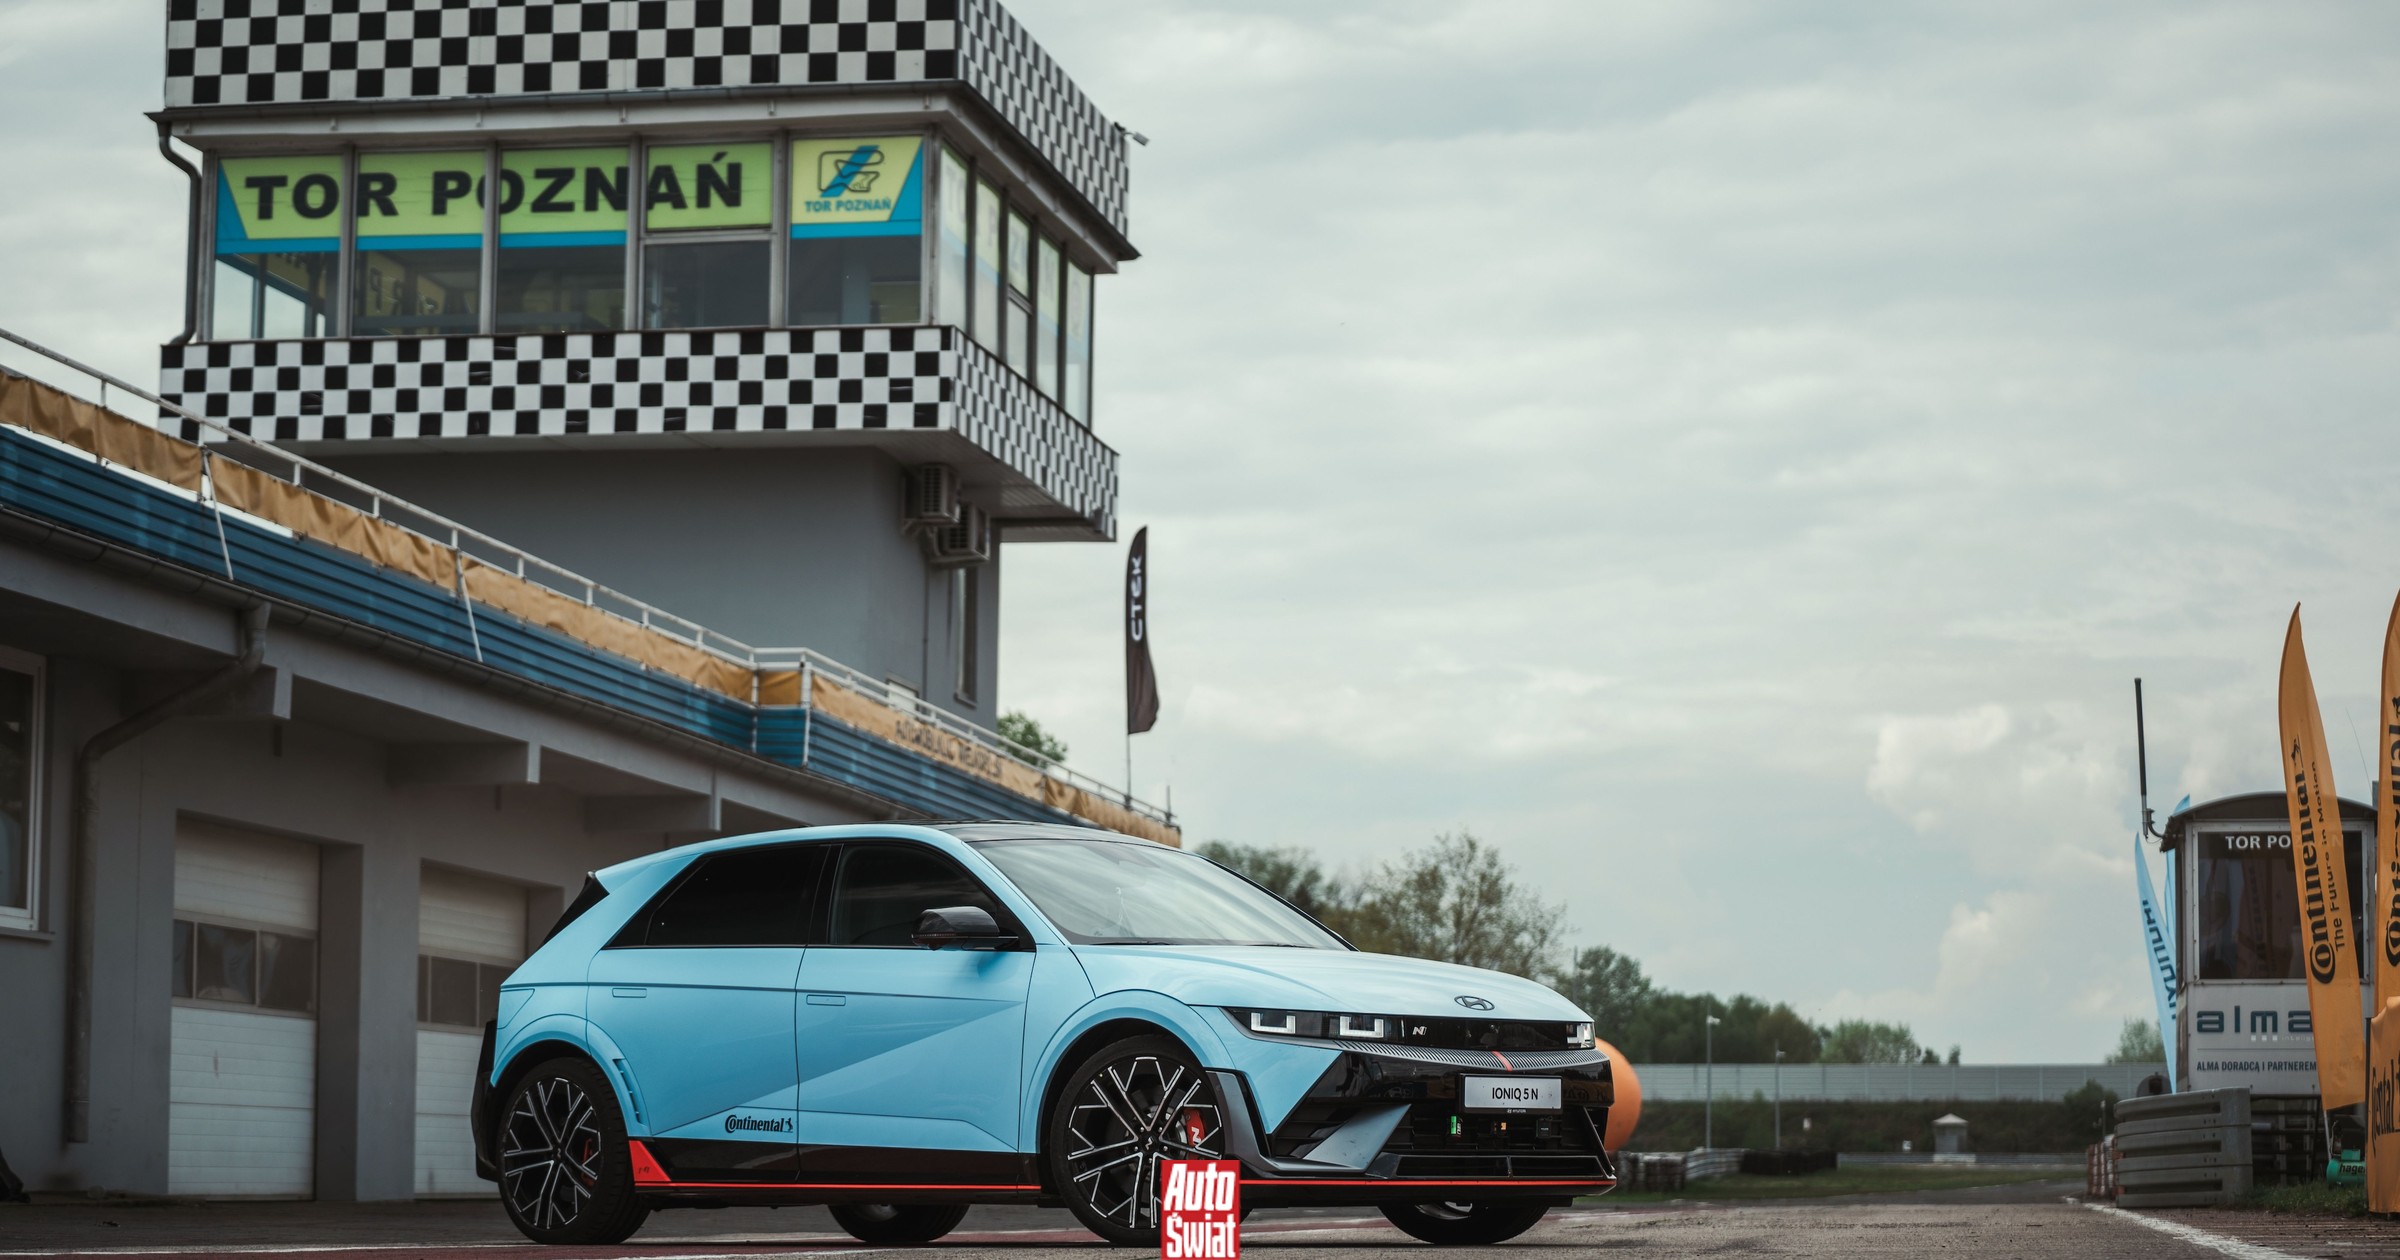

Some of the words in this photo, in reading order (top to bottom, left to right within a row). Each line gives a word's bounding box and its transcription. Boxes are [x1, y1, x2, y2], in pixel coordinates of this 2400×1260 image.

[245, 173, 399, 220] TOR
[432, 152, 742, 215] POZNAŃ
[805, 200, 832, 213] TOR
[835, 197, 892, 212] POZNAŃ
[1131, 555, 1143, 642] CTEK
[2311, 761, 2325, 823] Motion
[2225, 836, 2261, 850] TOR
[2321, 829, 2328, 846] in
[2294, 769, 2336, 985] Continental
[2325, 854, 2340, 912] Future
[2334, 917, 2345, 952] The
[2197, 1005, 2314, 1033] alma
[2197, 1061, 2220, 1072] ALMA
[2222, 1061, 2261, 1073] DORADCĄ
[2268, 1061, 2317, 1071] PARTNEREM
[1492, 1087, 1522, 1102] IONIQ
[1524, 1088, 1529, 1100] 5
[1532, 1088, 1538, 1100] N
[725, 1114, 784, 1133] Continental
